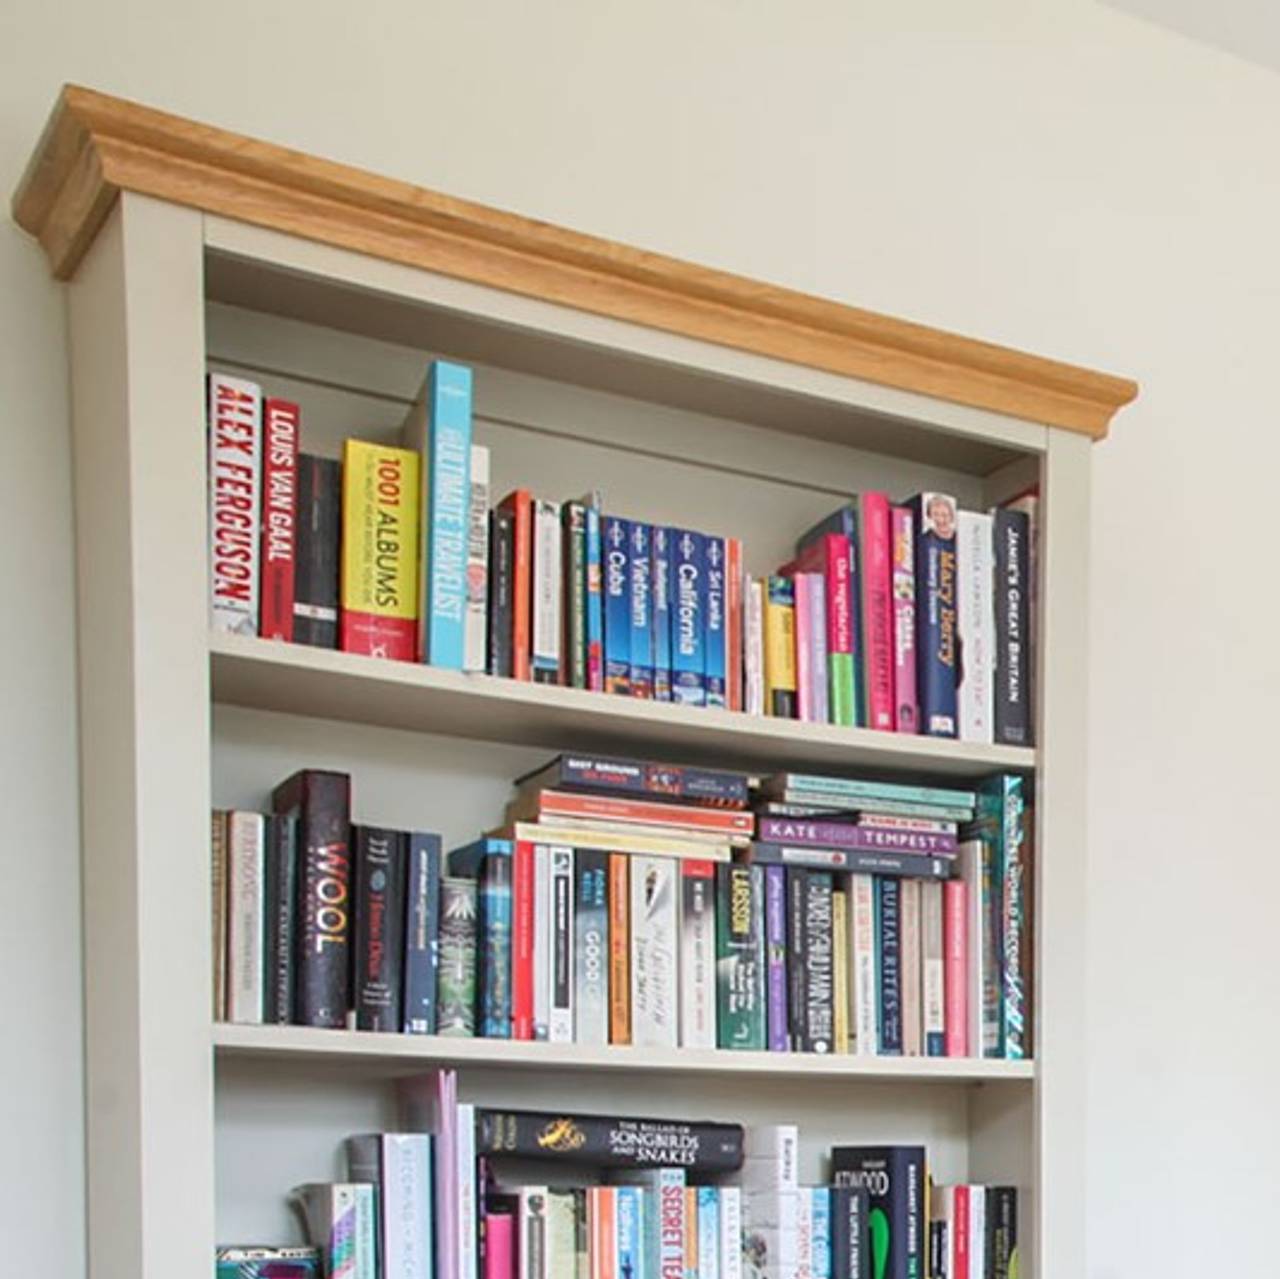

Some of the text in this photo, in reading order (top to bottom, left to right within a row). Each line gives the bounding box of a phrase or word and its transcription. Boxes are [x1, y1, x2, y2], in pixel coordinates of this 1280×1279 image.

[213, 384, 255, 602] ALEX FERGUSON
[268, 408, 296, 562] LOUIS VAN GAAL
[435, 440, 467, 526] ULTIMATE
[376, 458, 401, 607] 1001 ALBUMS
[434, 528, 465, 623] TRAVELIST
[608, 551, 627, 597] Cuba
[632, 556, 649, 629] Vietnam
[709, 570, 722, 631] Sri Lanka
[679, 563, 699, 656] California
[935, 550, 956, 668] Mary Berry
[1006, 588, 1021, 638] GREAT
[1006, 641, 1021, 703] BRITAIN
[768, 821, 939, 850] KATE TEMPEST
[316, 841, 347, 953] WOOL
[731, 869, 751, 935] LARSSON
[883, 880, 898, 949] BURIAL
[1006, 866, 1019, 917] WORLD
[585, 931, 599, 980] GOOD
[883, 955, 898, 1011] RITES
[610, 1129, 700, 1150] SONGBIRDS
[635, 1147, 698, 1166] SNAKES
[662, 1185, 684, 1248] SECRET
[907, 1163, 917, 1213] MARGARET
[907, 1214, 917, 1254] ATWOOD
[907, 1257, 917, 1276] THE
